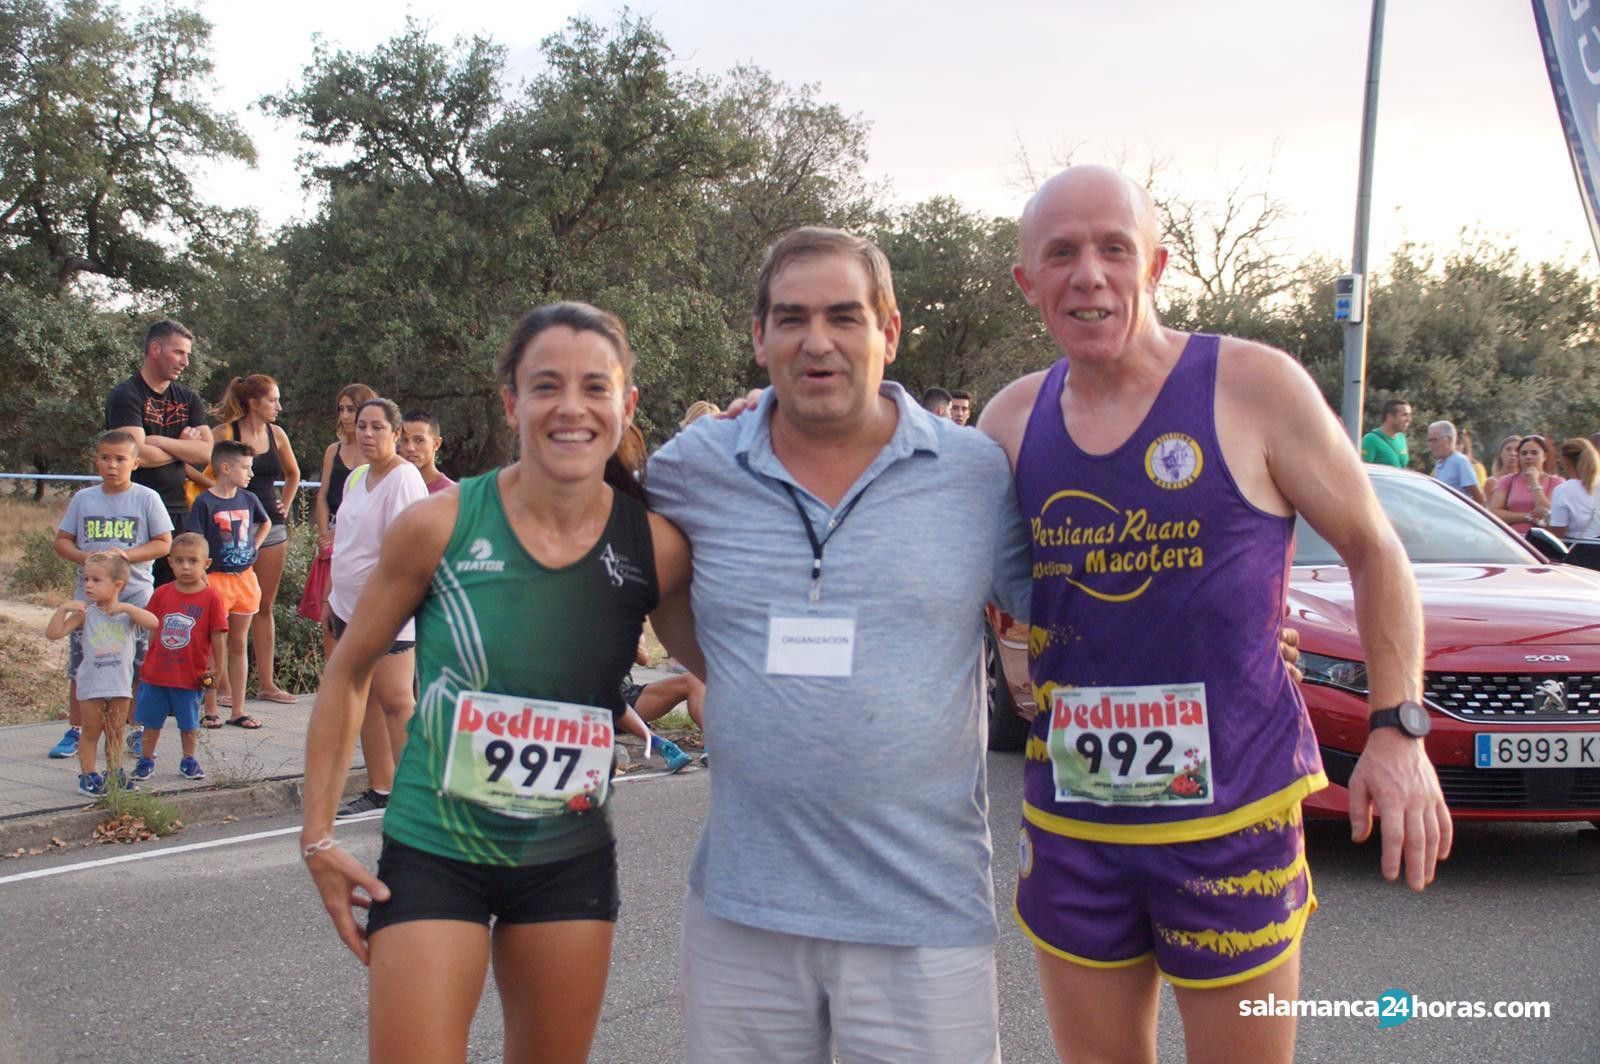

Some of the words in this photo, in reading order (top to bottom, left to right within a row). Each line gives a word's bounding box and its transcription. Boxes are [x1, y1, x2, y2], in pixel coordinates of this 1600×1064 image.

[87, 520, 135, 539] BLACK
[1030, 516, 1115, 547] Persianas
[1118, 508, 1201, 543] Ruano
[456, 560, 505, 572] VIATOR
[1085, 543, 1204, 574] Macotera
[1524, 654, 1571, 662] 508
[458, 700, 611, 749] bedunia
[1053, 694, 1204, 730] bedunia
[485, 740, 583, 791] 997
[1075, 730, 1176, 777] 992
[1498, 737, 1569, 763] 6993
[1580, 736, 1600, 763] K
